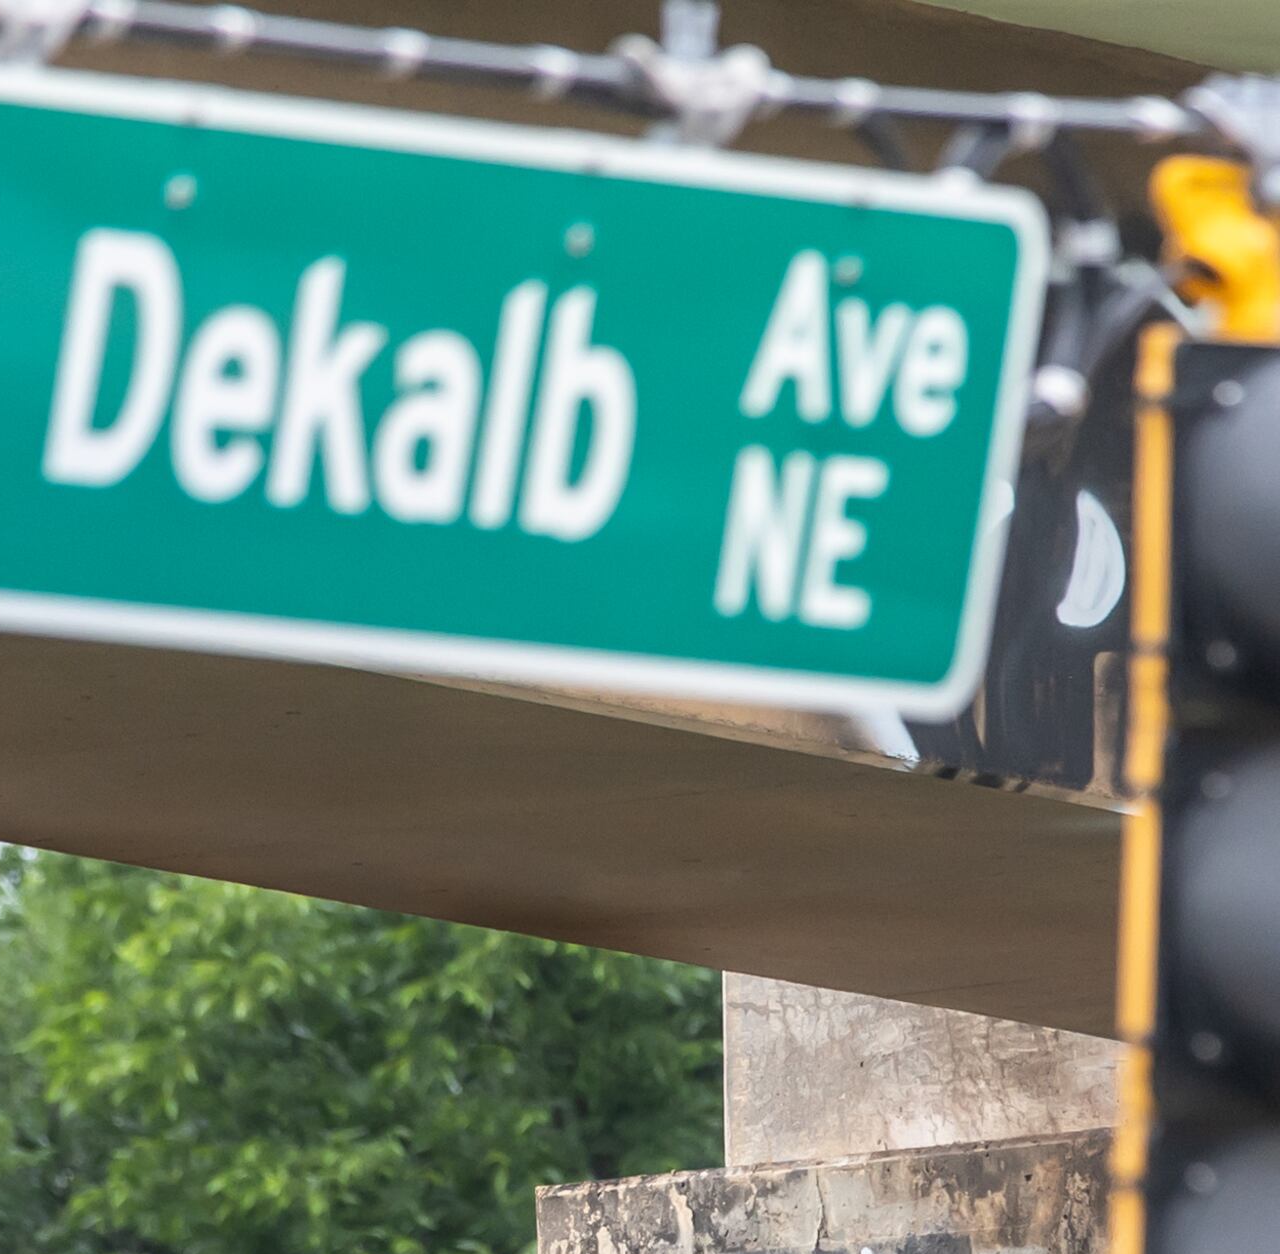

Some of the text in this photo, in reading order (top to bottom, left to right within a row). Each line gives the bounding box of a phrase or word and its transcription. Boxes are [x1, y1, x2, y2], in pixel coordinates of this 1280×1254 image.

[42, 228, 636, 542] Dekalb
[739, 250, 969, 437] Ave
[713, 445, 890, 630] NE
